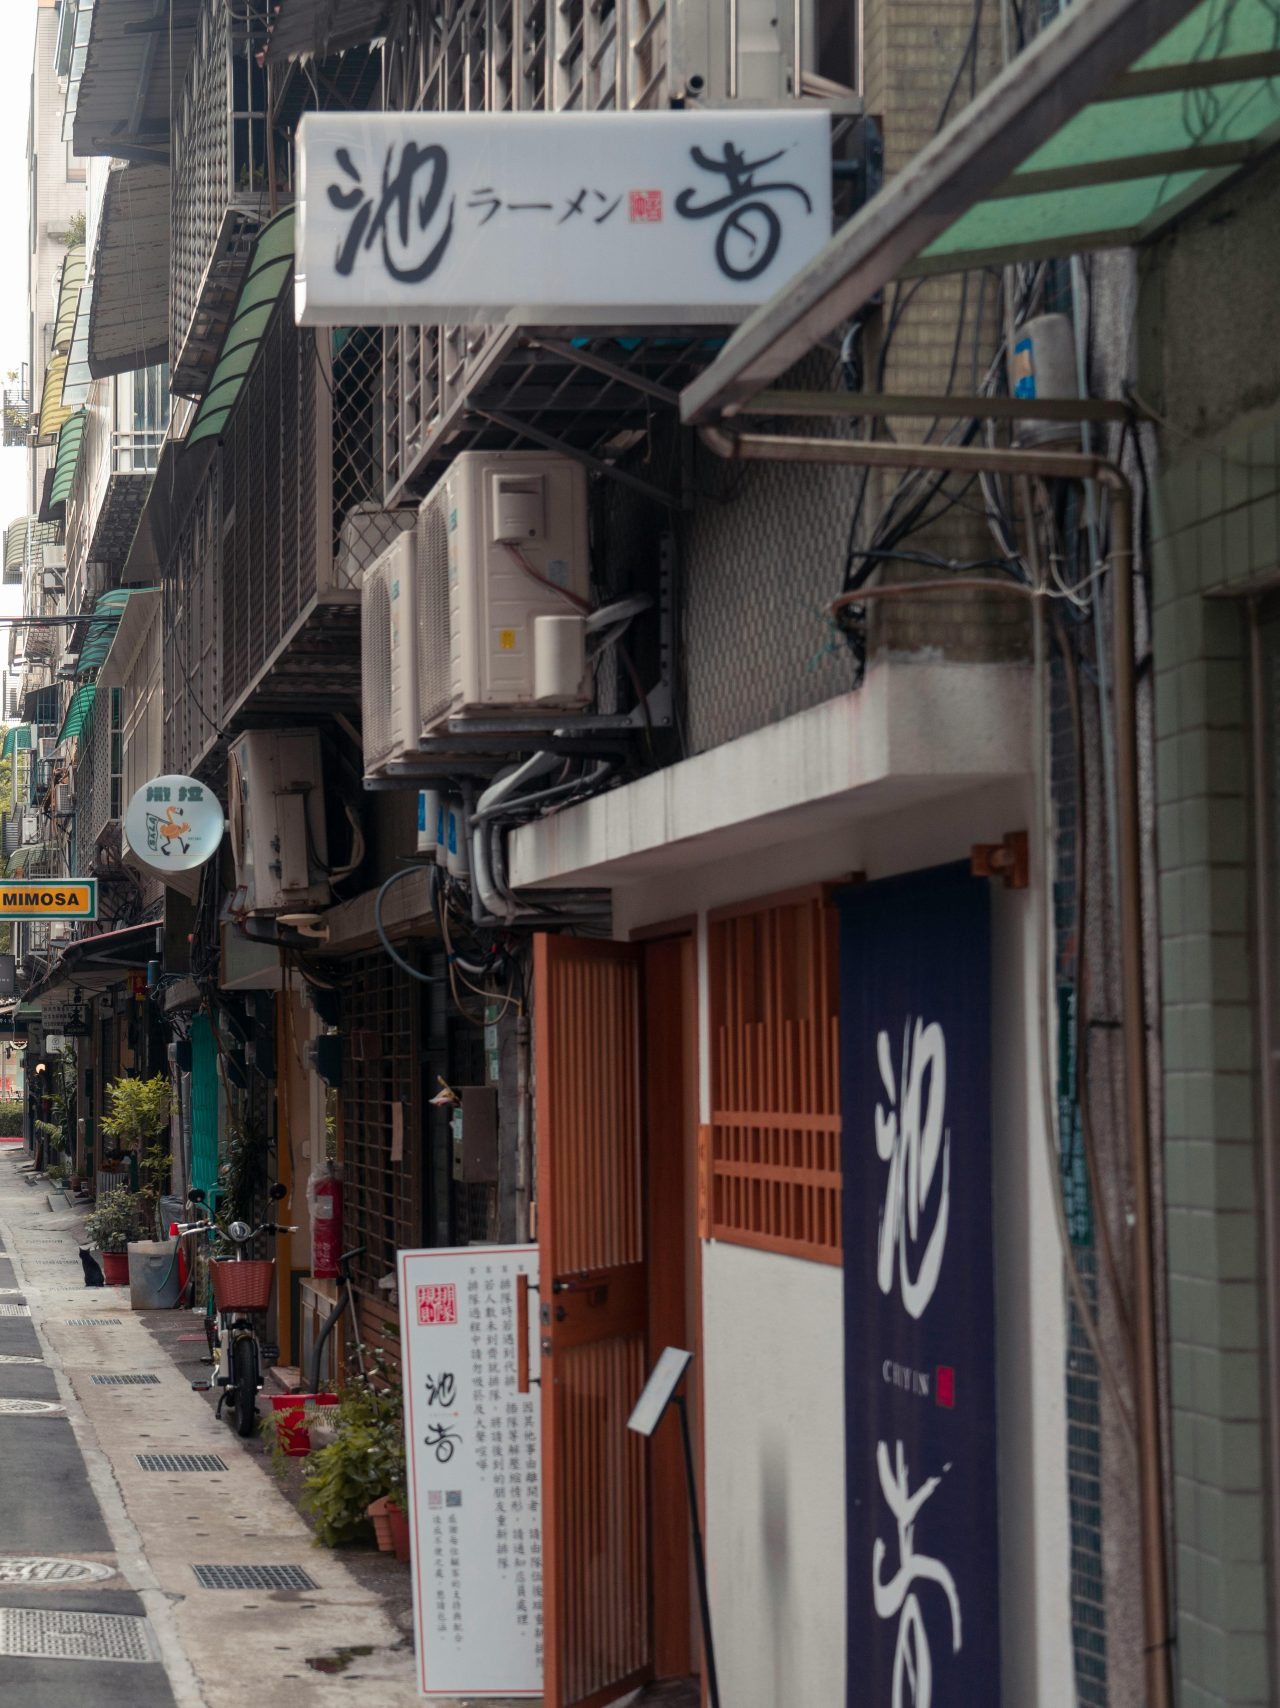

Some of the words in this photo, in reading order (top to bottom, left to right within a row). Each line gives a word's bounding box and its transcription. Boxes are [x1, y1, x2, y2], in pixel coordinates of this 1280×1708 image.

[466, 187, 623, 226] ラーメン
[2, 893, 80, 906] MIMOSA
